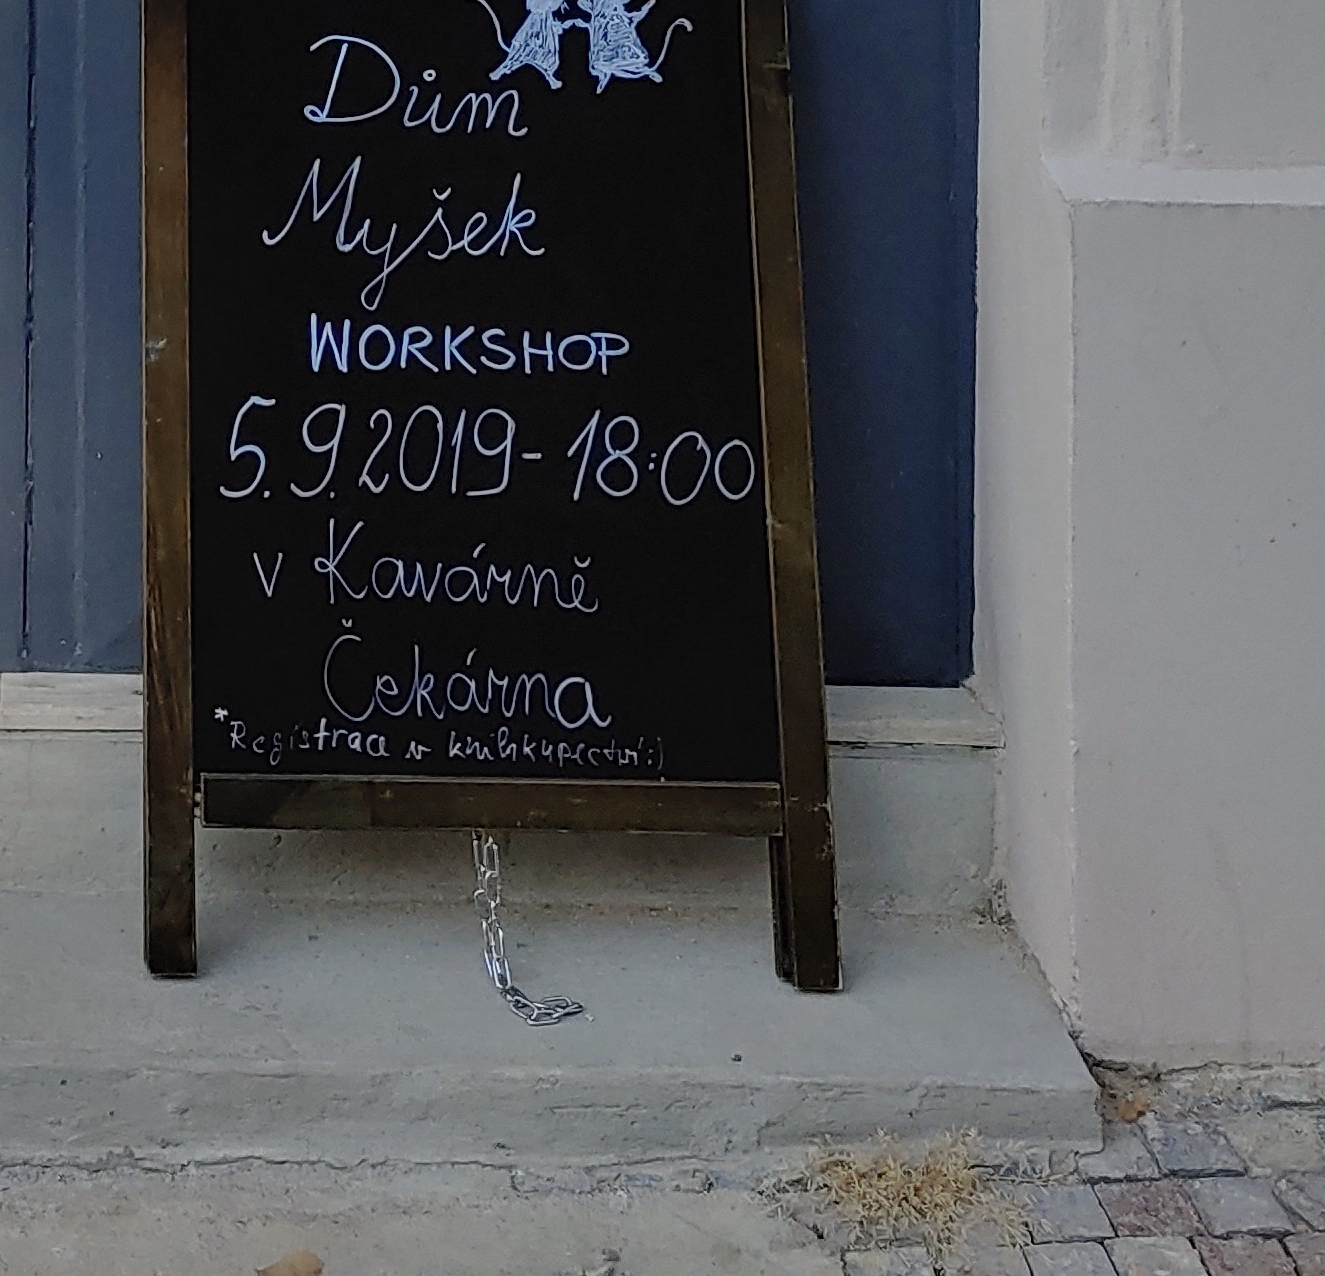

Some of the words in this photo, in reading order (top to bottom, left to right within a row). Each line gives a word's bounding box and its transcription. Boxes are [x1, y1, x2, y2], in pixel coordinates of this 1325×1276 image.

[302, 33, 529, 138] Dům
[262, 154, 546, 311] Myšek
[310, 312, 631, 376] WORKSHOP
[565, 408, 757, 507] 18:00
[313, 517, 600, 613] Kavárně
[323, 619, 613, 730] Čekárna
